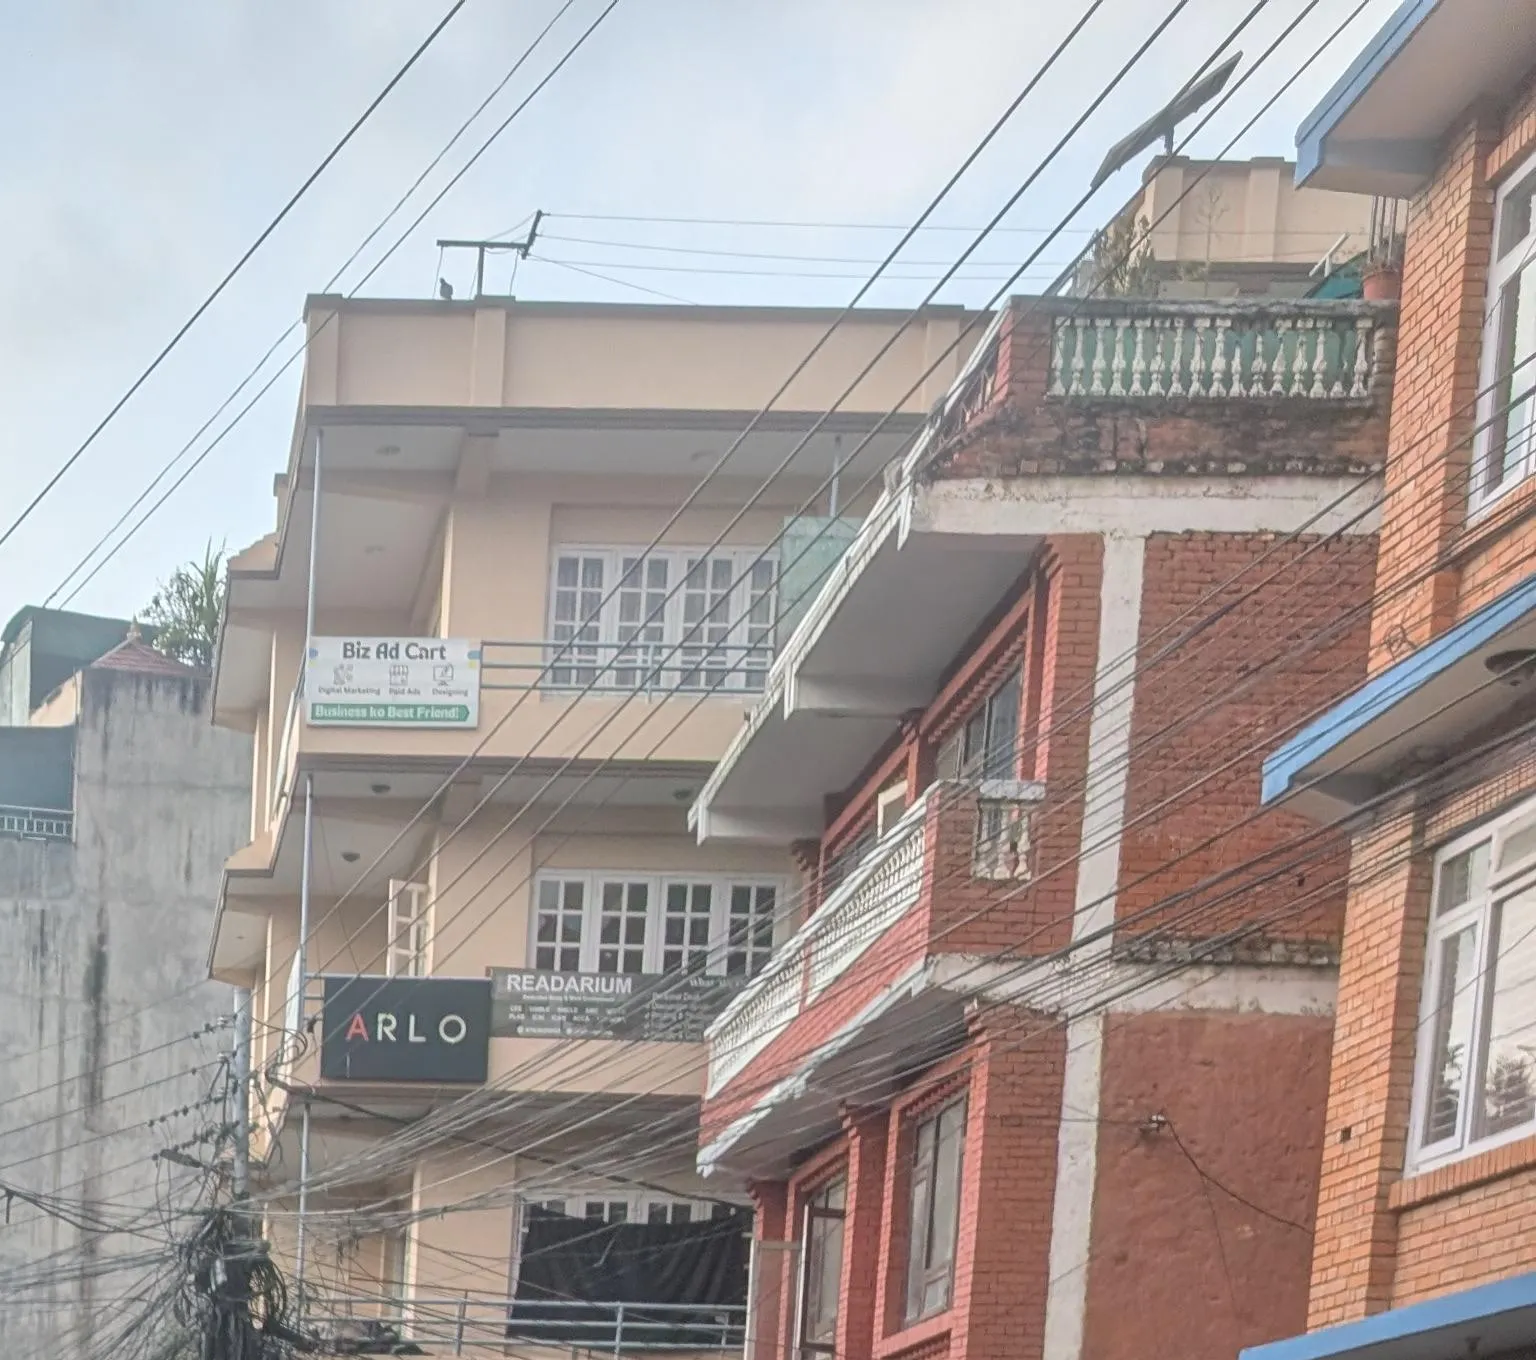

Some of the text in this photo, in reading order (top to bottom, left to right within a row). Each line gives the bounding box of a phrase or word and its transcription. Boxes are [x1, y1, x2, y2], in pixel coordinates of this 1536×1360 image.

[343, 641, 447, 660] Biz Ad Cart
[315, 704, 367, 718] Business
[369, 704, 385, 718] ko
[387, 704, 415, 718] Best
[507, 974, 632, 994] READARIUM
[346, 1012, 467, 1044] ARLO
